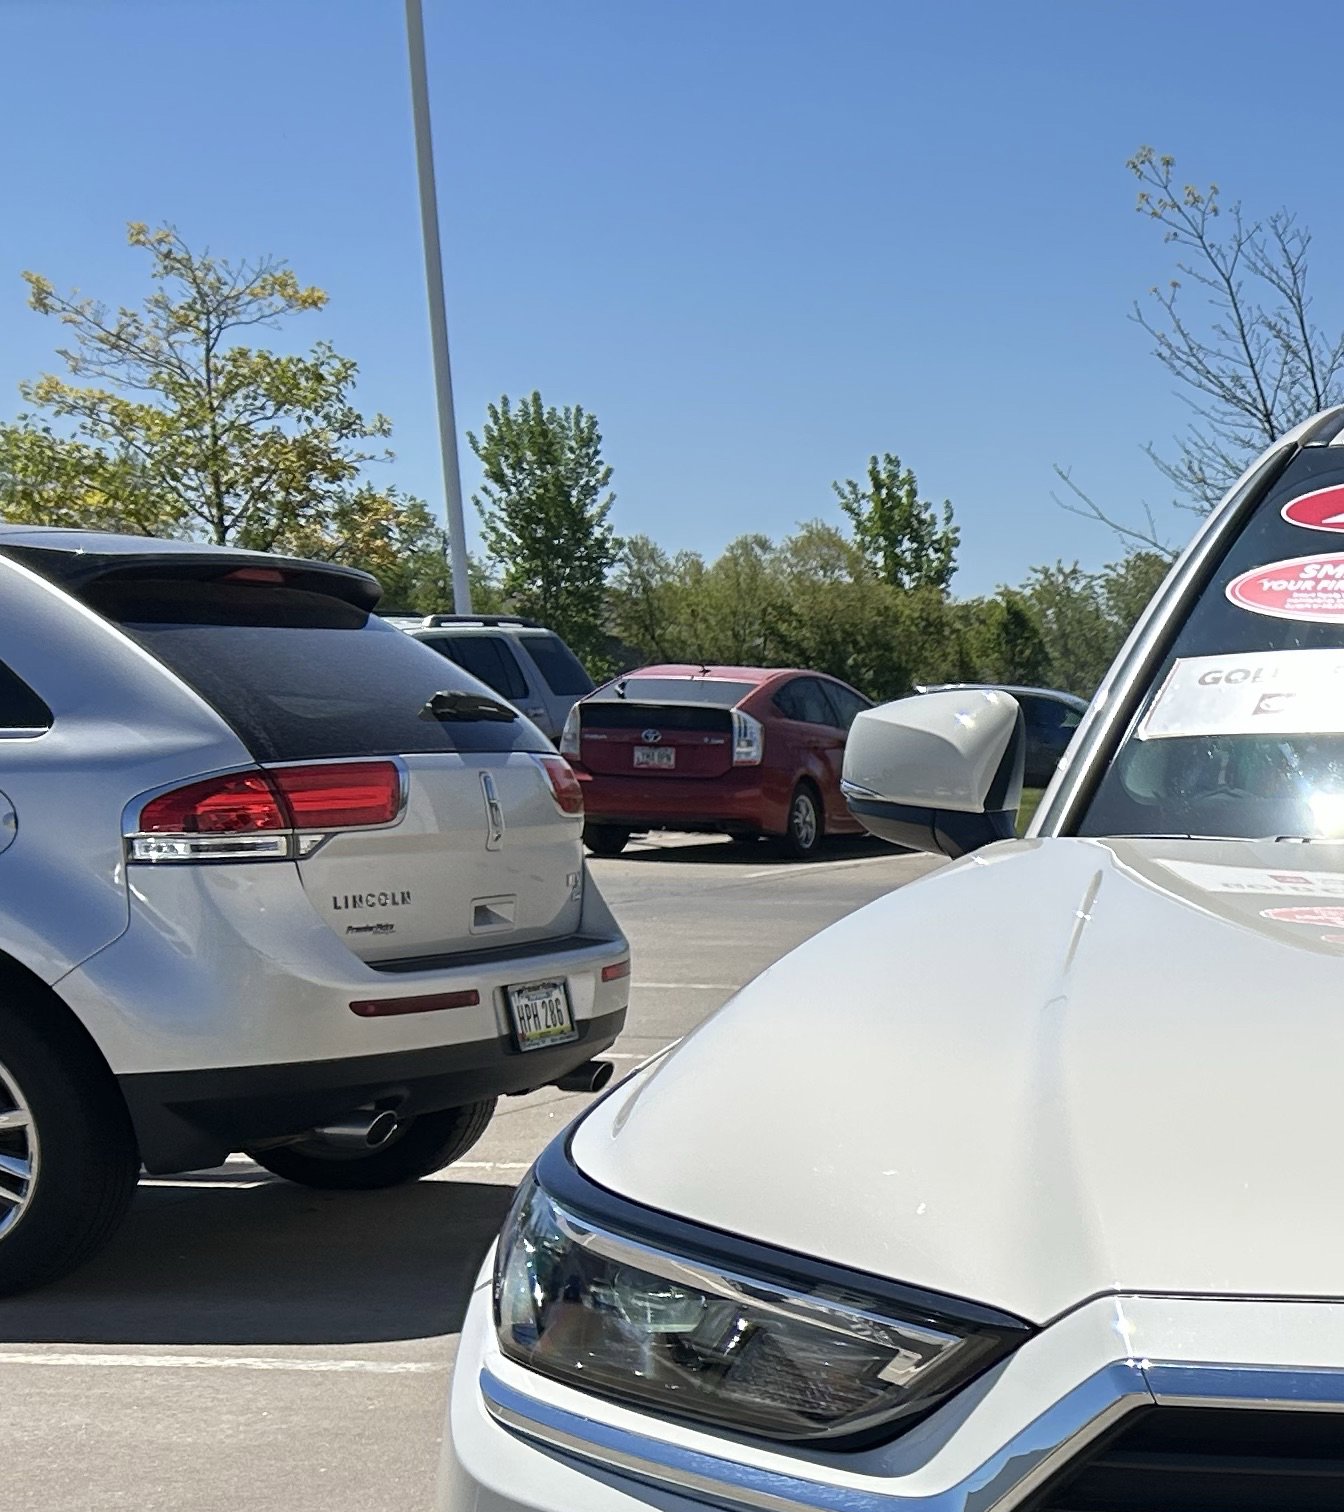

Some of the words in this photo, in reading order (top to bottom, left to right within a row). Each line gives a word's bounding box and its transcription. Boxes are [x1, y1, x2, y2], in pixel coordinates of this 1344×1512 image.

[1259, 578, 1316, 592] YOUR
[1197, 667, 1281, 686] GOL
[331, 889, 412, 911] LINCOLN
[517, 1001, 543, 1034] HPH
[541, 997, 565, 1029] 286
